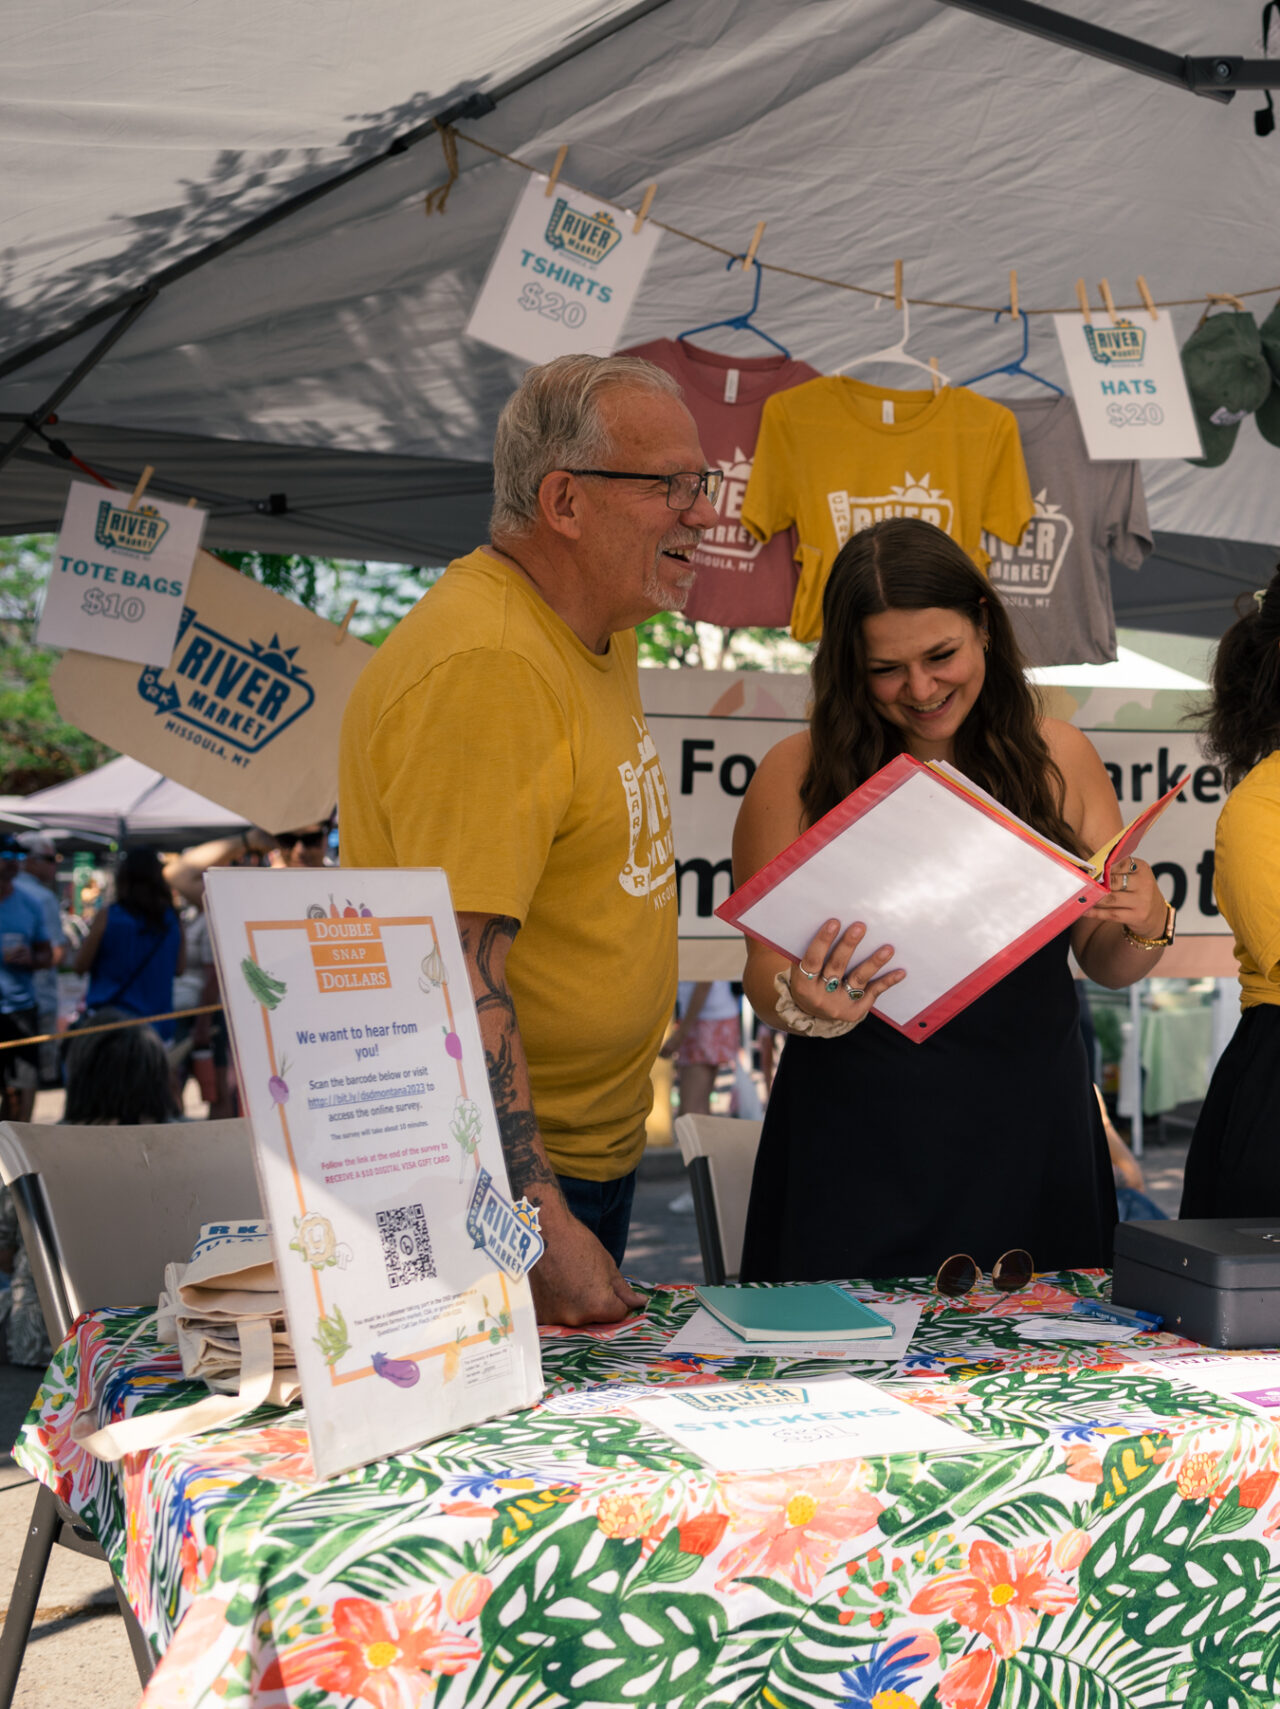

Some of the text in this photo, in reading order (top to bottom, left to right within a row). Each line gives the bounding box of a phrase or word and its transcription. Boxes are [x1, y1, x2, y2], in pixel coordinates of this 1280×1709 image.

[562, 213, 611, 249] RIVER
[521, 249, 613, 303] TSHIRTS
[518, 282, 587, 329] $20
[1097, 331, 1140, 349] RIVER
[1100, 380, 1157, 395] HATS
[1106, 402, 1165, 428] $20
[110, 513, 158, 539] RIVER
[703, 524, 755, 546] ARKE
[979, 522, 1056, 561] IER
[60, 556, 183, 597] TOTE BAGS
[989, 561, 1051, 582] MARKET
[81, 587, 145, 623] $10
[142, 664, 174, 706] ORK
[177, 635, 292, 724] RIVER
[187, 690, 267, 741] MARKET
[164, 719, 250, 769] MISSOULA, MT
[680, 738, 1223, 803] Fo arke
[314, 922, 374, 938] DOUBLE
[332, 948, 366, 961] SNAP
[320, 972, 387, 989] DOLLARS
[296, 1021, 418, 1044] We want to hear from
[355, 1043, 380, 1061] you!
[309, 1066, 429, 1090] Scan the barcode below or visit
[426, 1082, 436, 1092] to
[328, 1101, 423, 1122] access the online survey.
[321, 1160, 344, 1171] Follow
[344, 1157, 356, 1166] the
[370, 1154, 377, 1162] at
[377, 1152, 388, 1161] the
[389, 1150, 401, 1159] end
[401, 1148, 409, 1157] of
[409, 1147, 420, 1156] the
[420, 1144, 441, 1154] survey
[441, 1142, 449, 1150] to
[324, 1171, 355, 1185] RECEIVE
[374, 1163, 401, 1175] DIGITAL
[401, 1160, 417, 1171] VISA
[417, 1158, 432, 1168] GIFT
[433, 1154, 451, 1165] CARD
[483, 1195, 532, 1263] RIVER
[487, 1233, 523, 1274] MARKET
[703, 1387, 792, 1405] RIVER
[673, 1406, 902, 1432] STICKERS
